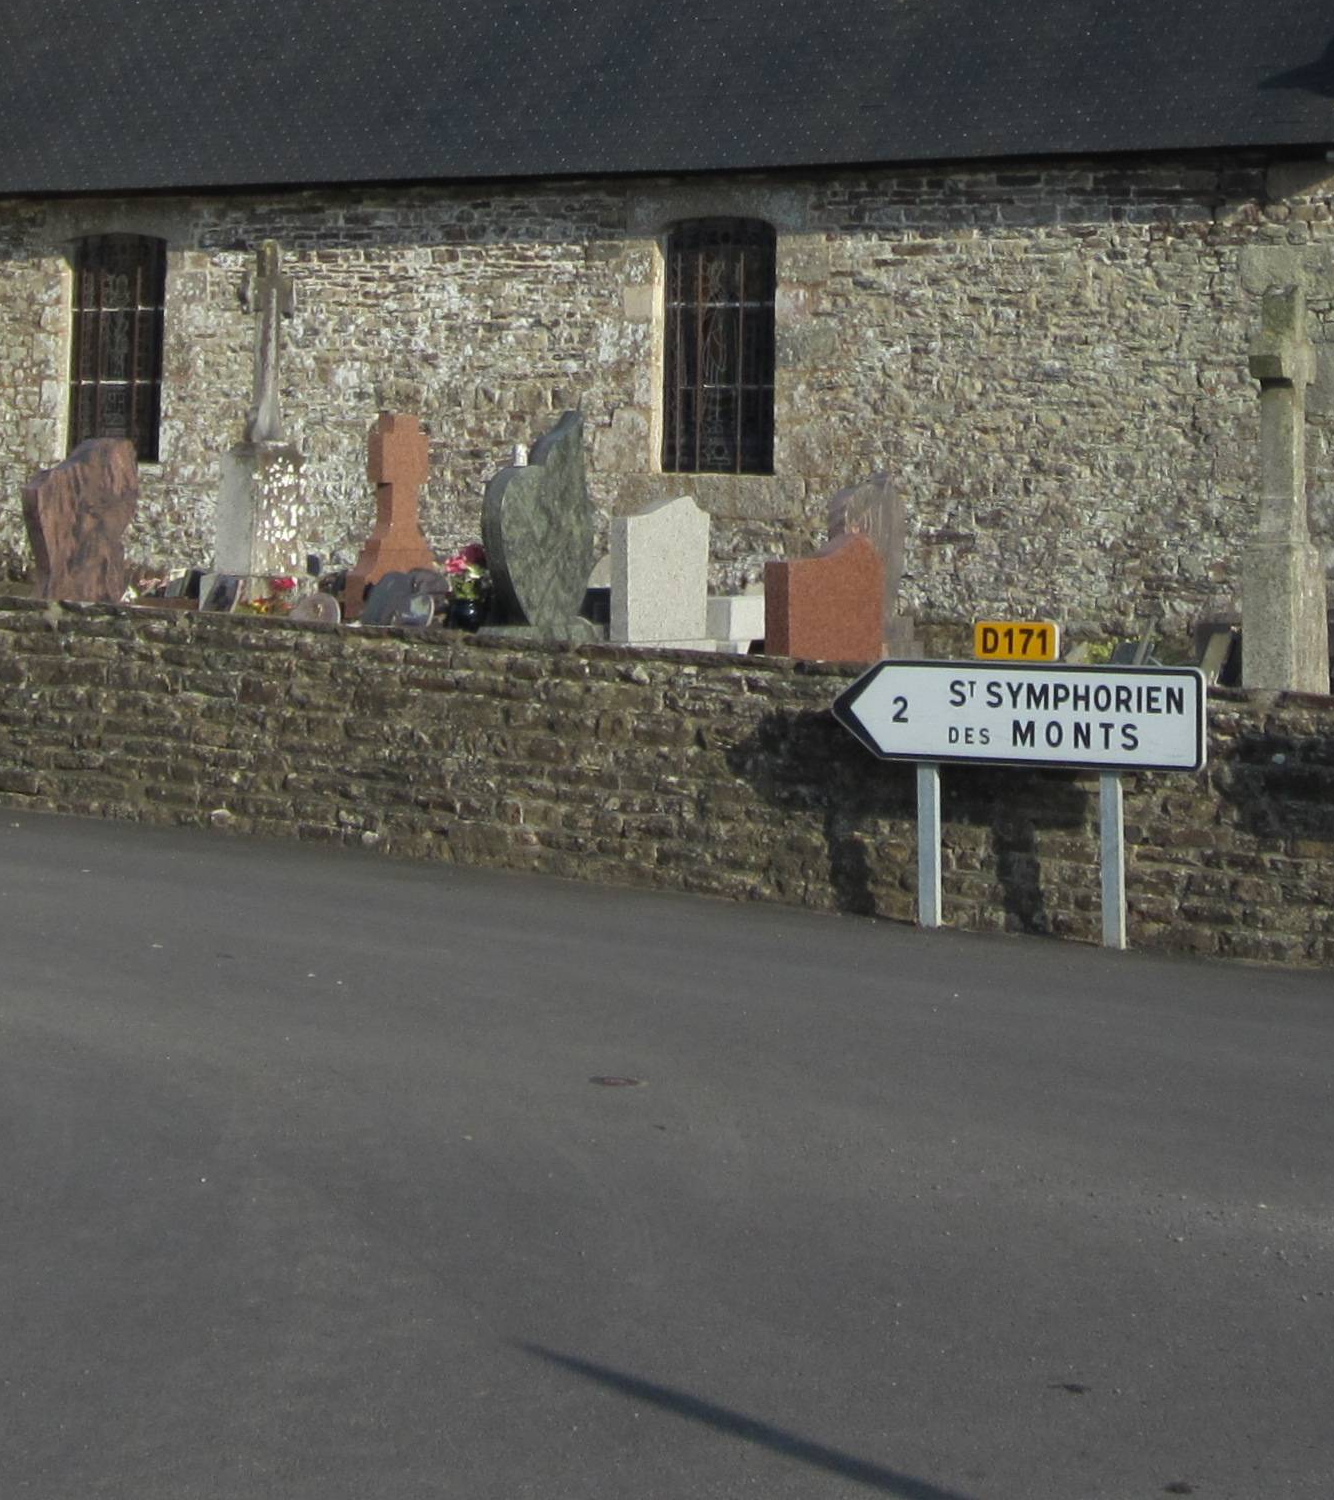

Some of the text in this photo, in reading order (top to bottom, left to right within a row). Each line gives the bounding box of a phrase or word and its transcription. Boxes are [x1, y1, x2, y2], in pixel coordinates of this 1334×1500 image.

[982, 627, 1048, 655] D171
[892, 696, 908, 723] 2
[986, 681, 1184, 715] SYMPHORIEN
[948, 720, 1139, 751] DES MONTS
